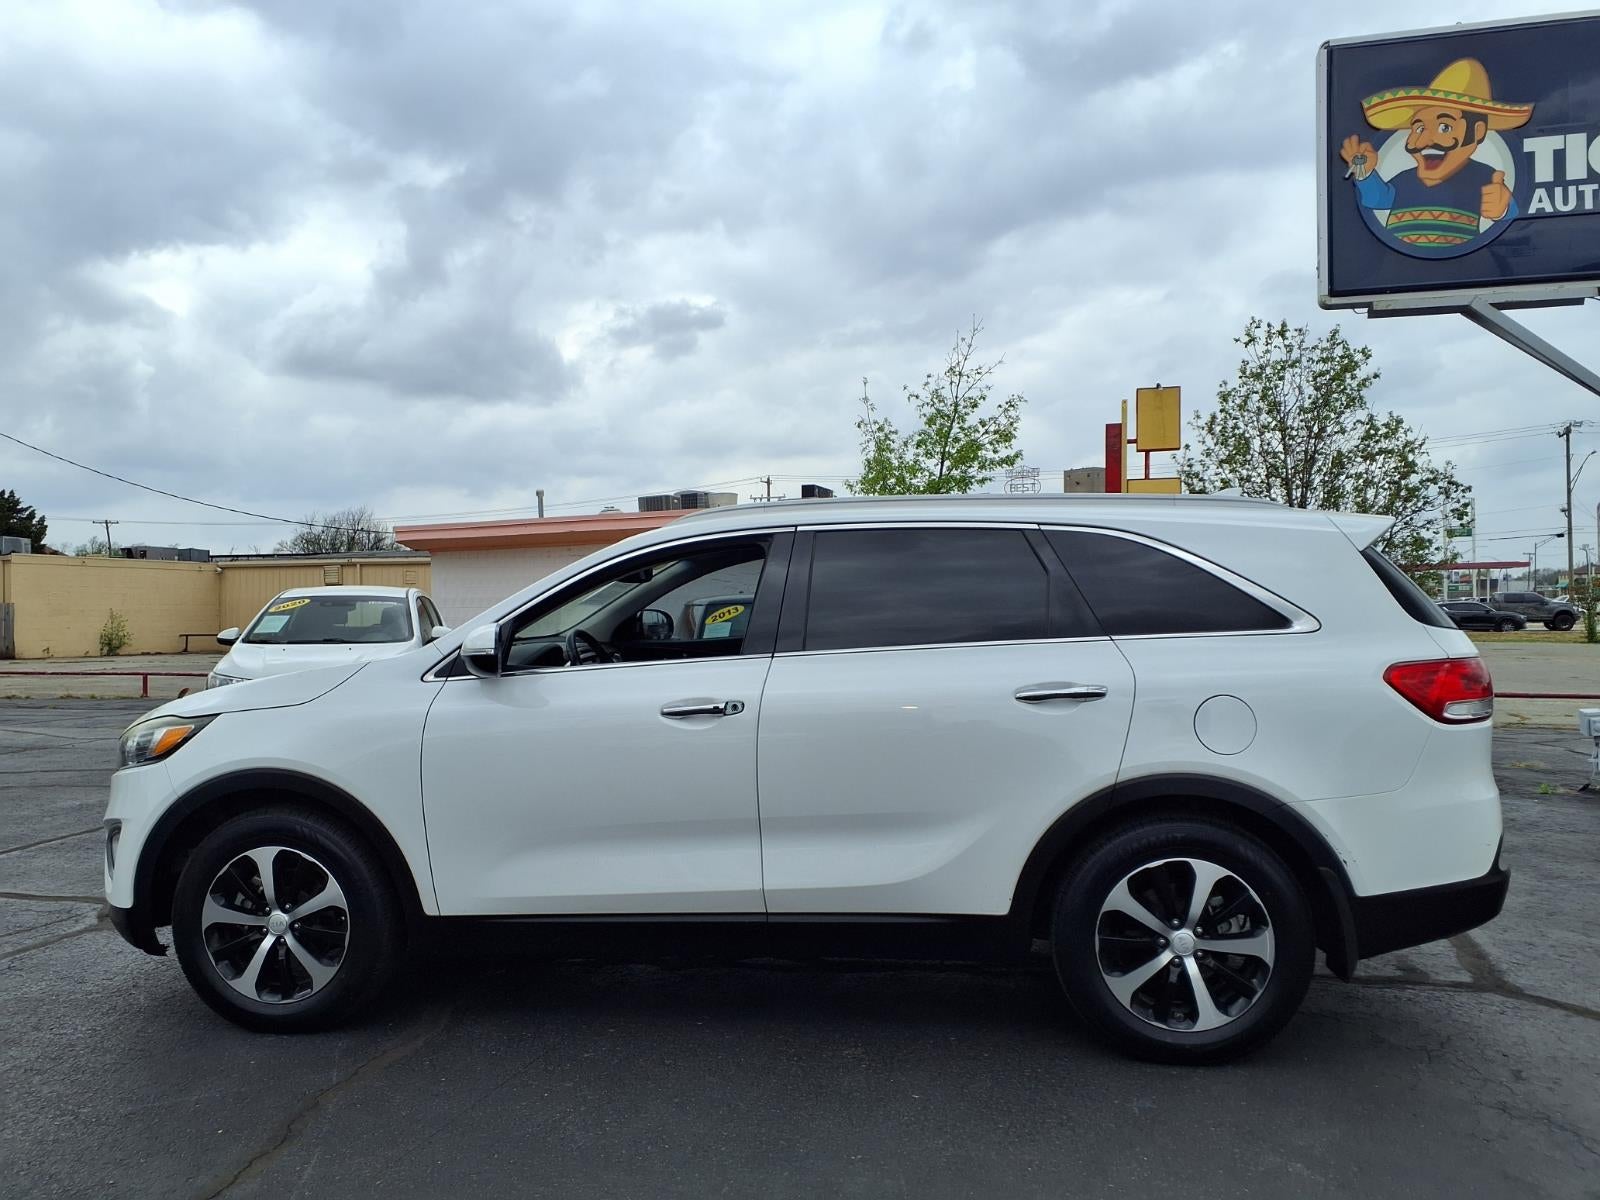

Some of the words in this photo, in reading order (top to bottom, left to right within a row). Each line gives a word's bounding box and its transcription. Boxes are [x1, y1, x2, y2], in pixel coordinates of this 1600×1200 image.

[1523, 132, 1600, 183] TI
[1528, 184, 1600, 214] AUT
[1009, 483, 1036, 493] BEST
[711, 606, 739, 622] 2013
